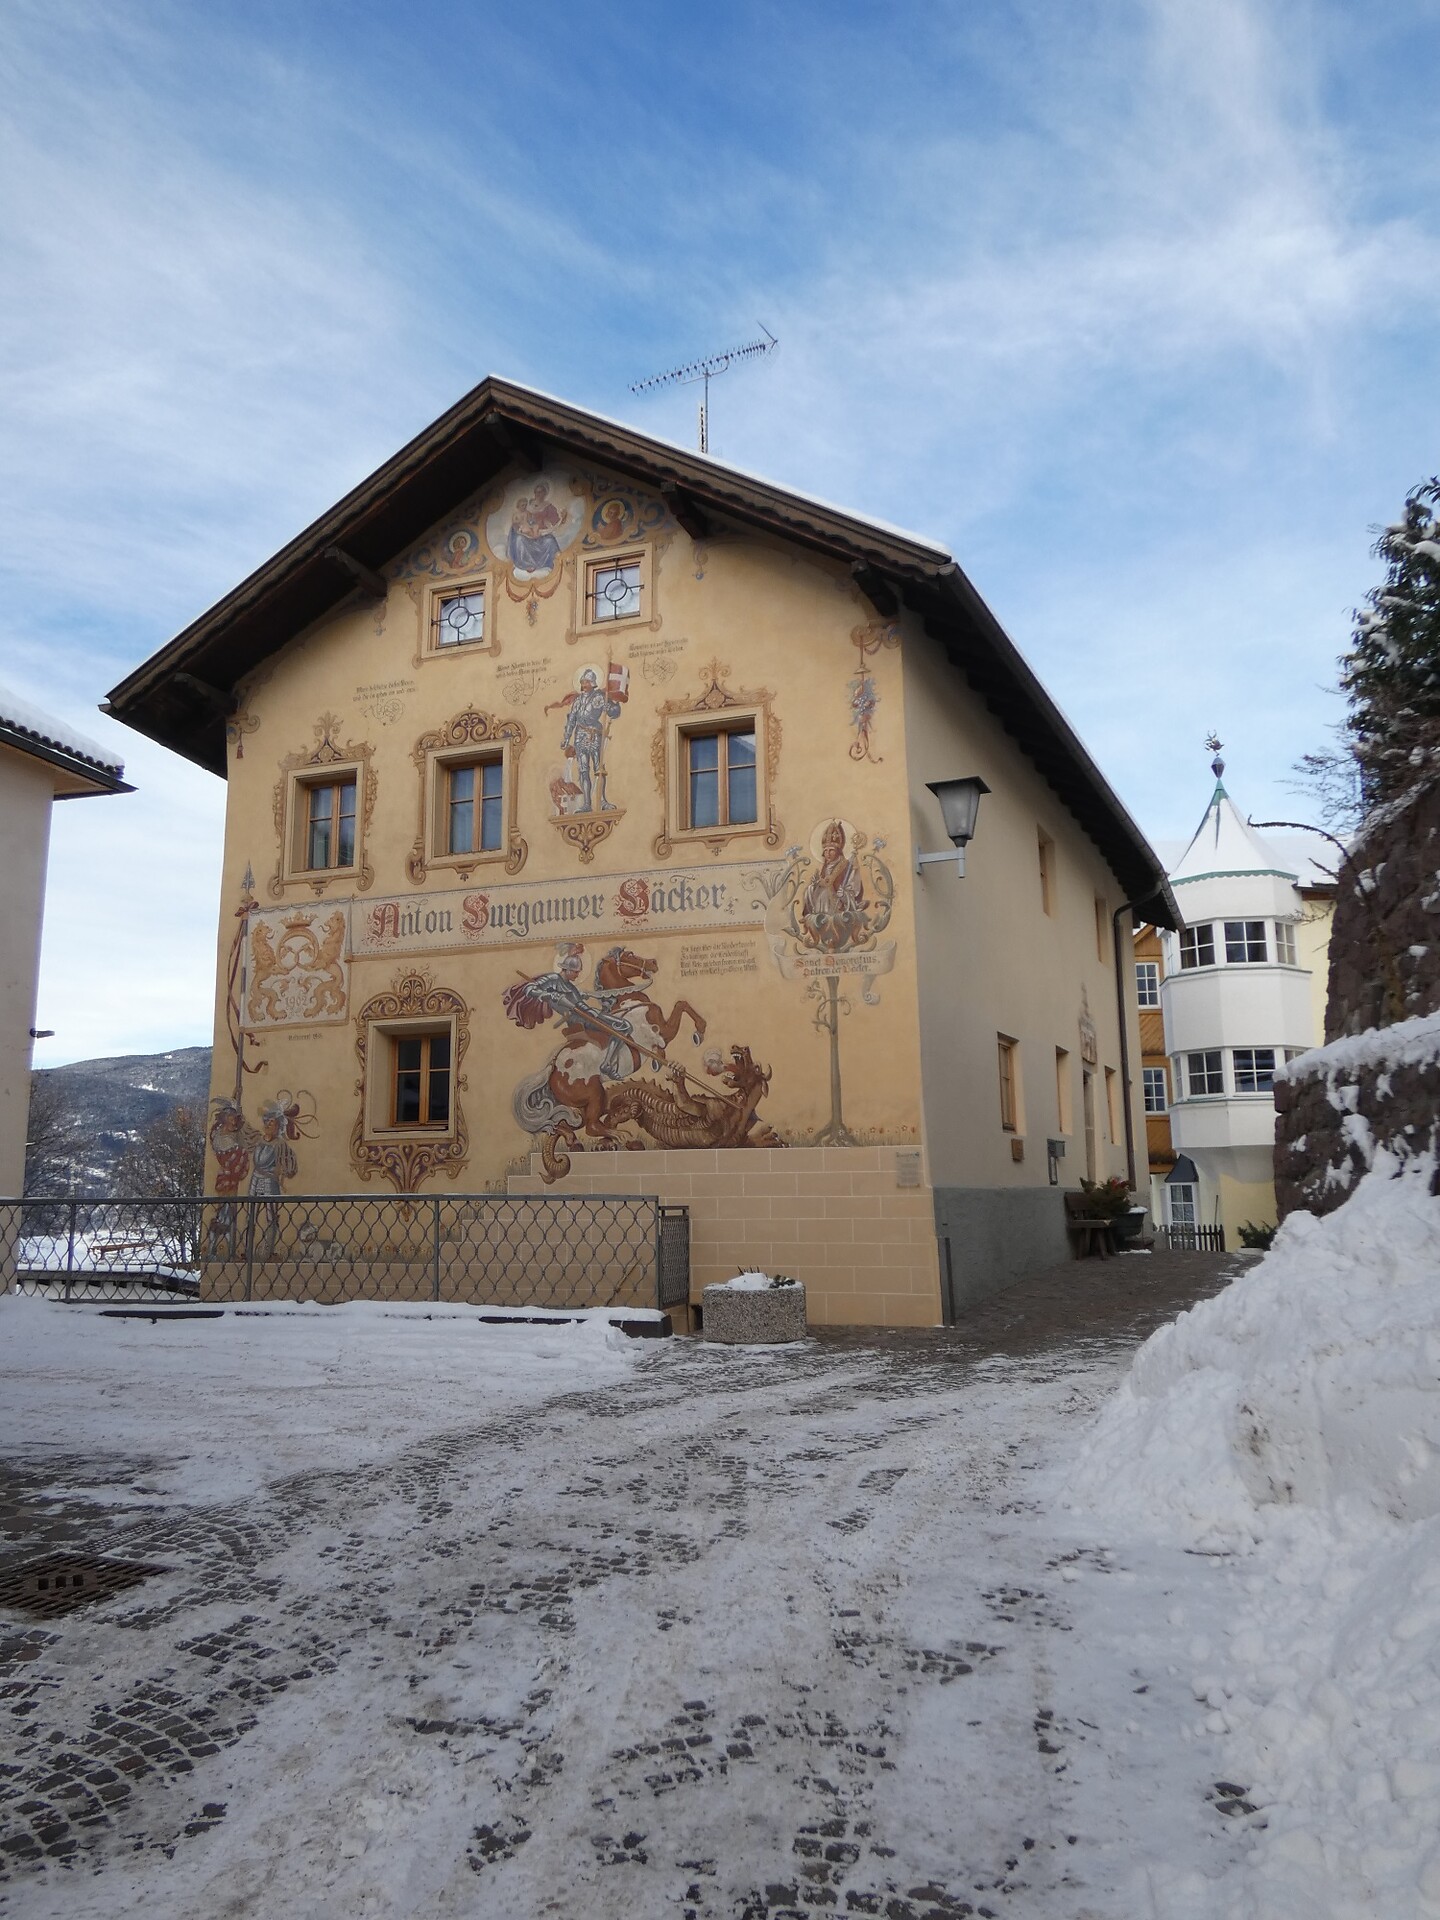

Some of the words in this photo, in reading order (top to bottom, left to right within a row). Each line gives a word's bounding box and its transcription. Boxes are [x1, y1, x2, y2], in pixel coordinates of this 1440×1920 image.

[366, 900, 453, 945] Anton
[461, 892, 605, 940] Burgauner
[286, 995, 307, 1009] 1902
